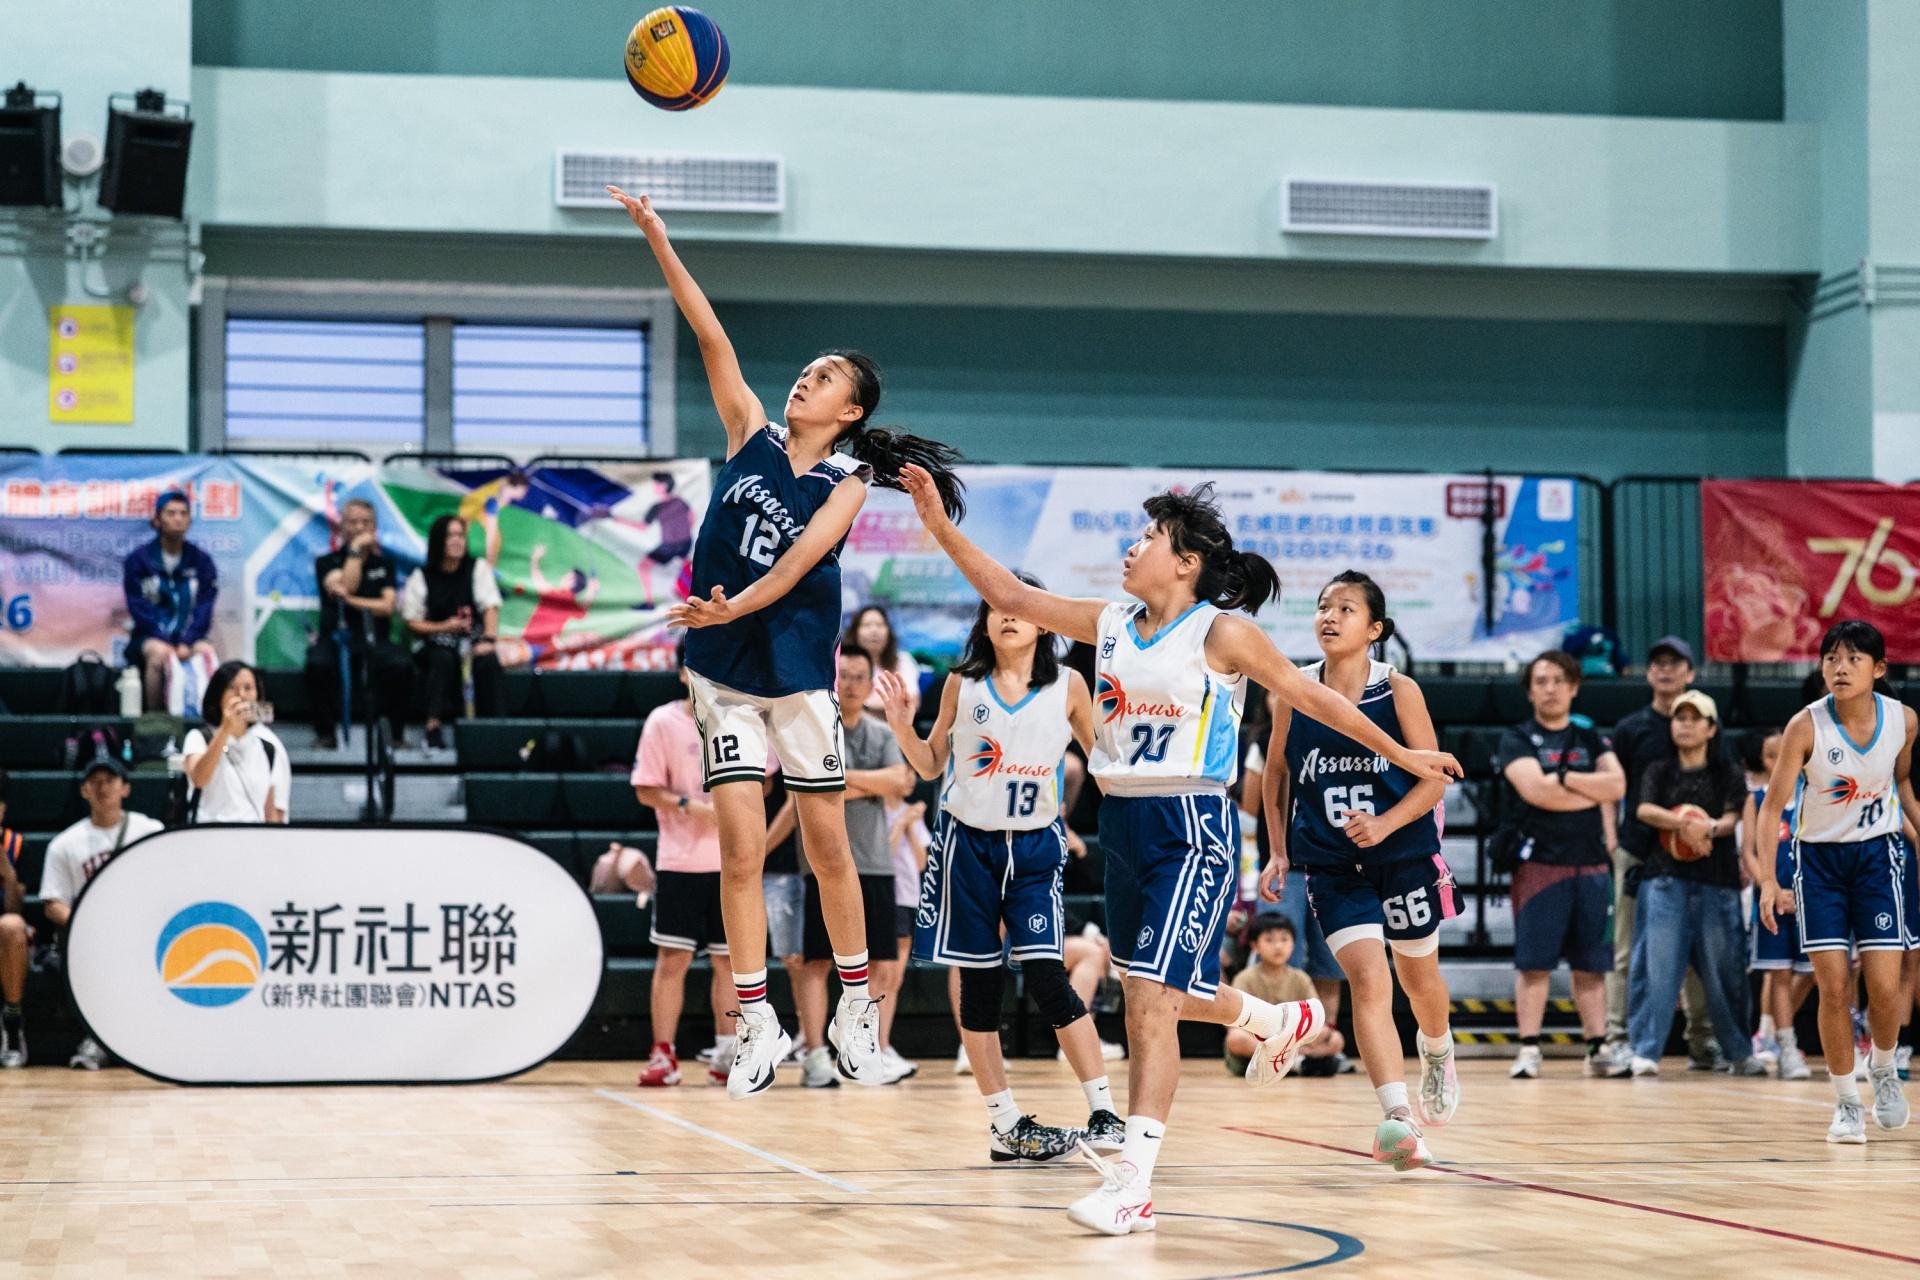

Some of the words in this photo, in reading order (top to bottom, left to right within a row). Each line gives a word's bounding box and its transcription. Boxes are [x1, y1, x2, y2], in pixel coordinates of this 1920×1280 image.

[739, 513, 781, 567] 12
[1806, 517, 1917, 618] 76
[0, 593, 32, 630] 6
[713, 734, 740, 764] 12
[1006, 781, 1040, 818] 13
[1383, 886, 1432, 930] 66
[268, 901, 518, 976] 新社聯
[429, 983, 517, 1008] NTAS
